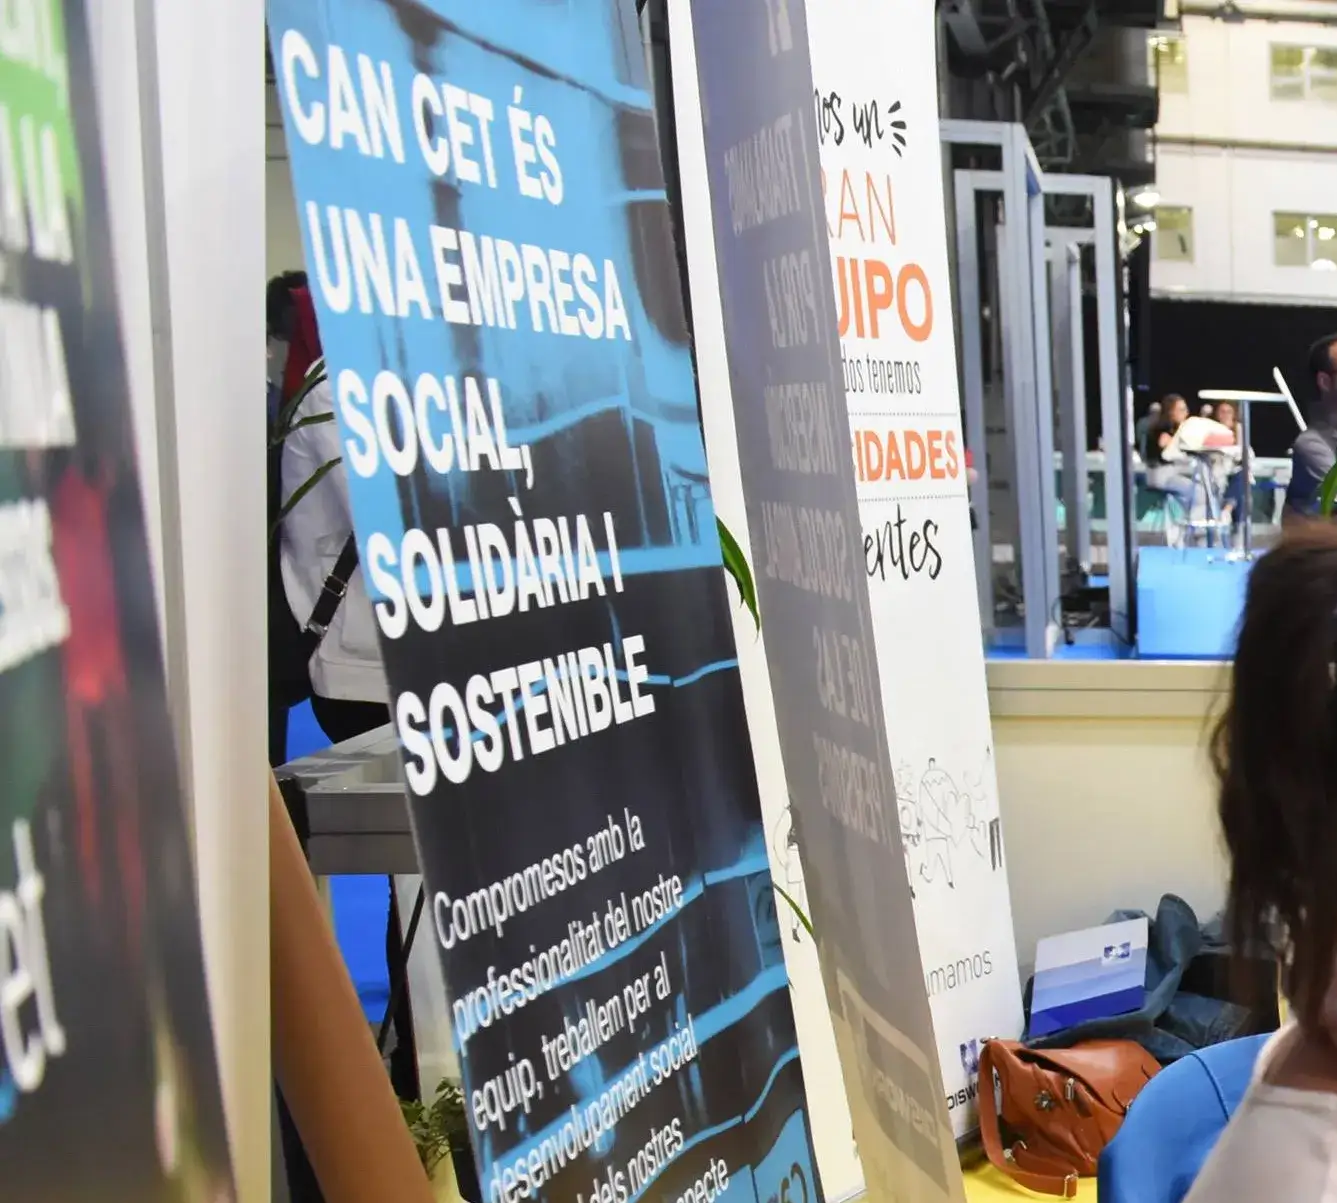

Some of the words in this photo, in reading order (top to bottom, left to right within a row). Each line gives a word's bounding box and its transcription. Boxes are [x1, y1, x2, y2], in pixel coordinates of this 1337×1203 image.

[281, 29, 405, 163] CAN
[412, 72, 497, 189] CET
[507, 85, 564, 205] ÉS
[852, 99, 884, 149] un
[306, 201, 434, 320] UNA
[430, 225, 632, 341] EMPRESA
[337, 369, 533, 490] SOCIAL,
[866, 353, 922, 394] tenemos
[367, 497, 606, 640] SOLIDÀRIA
[604, 511, 624, 594] I
[397, 635, 656, 796] SOSTENIBLE
[434, 843, 588, 949] Compromesos
[586, 814, 625, 873] amb
[624, 807, 645, 852] la
[453, 911, 606, 1058] professionalitat
[604, 892, 632, 949] del
[632, 874, 683, 932] nostre
[471, 1052, 543, 1131] equip,
[541, 996, 625, 1081] treballem
[624, 972, 652, 1033] per
[654, 951, 671, 1001] al
[650, 1013, 698, 1085] social
[946, 1082, 979, 1110] DISW
[628, 1117, 685, 1195] nostres
